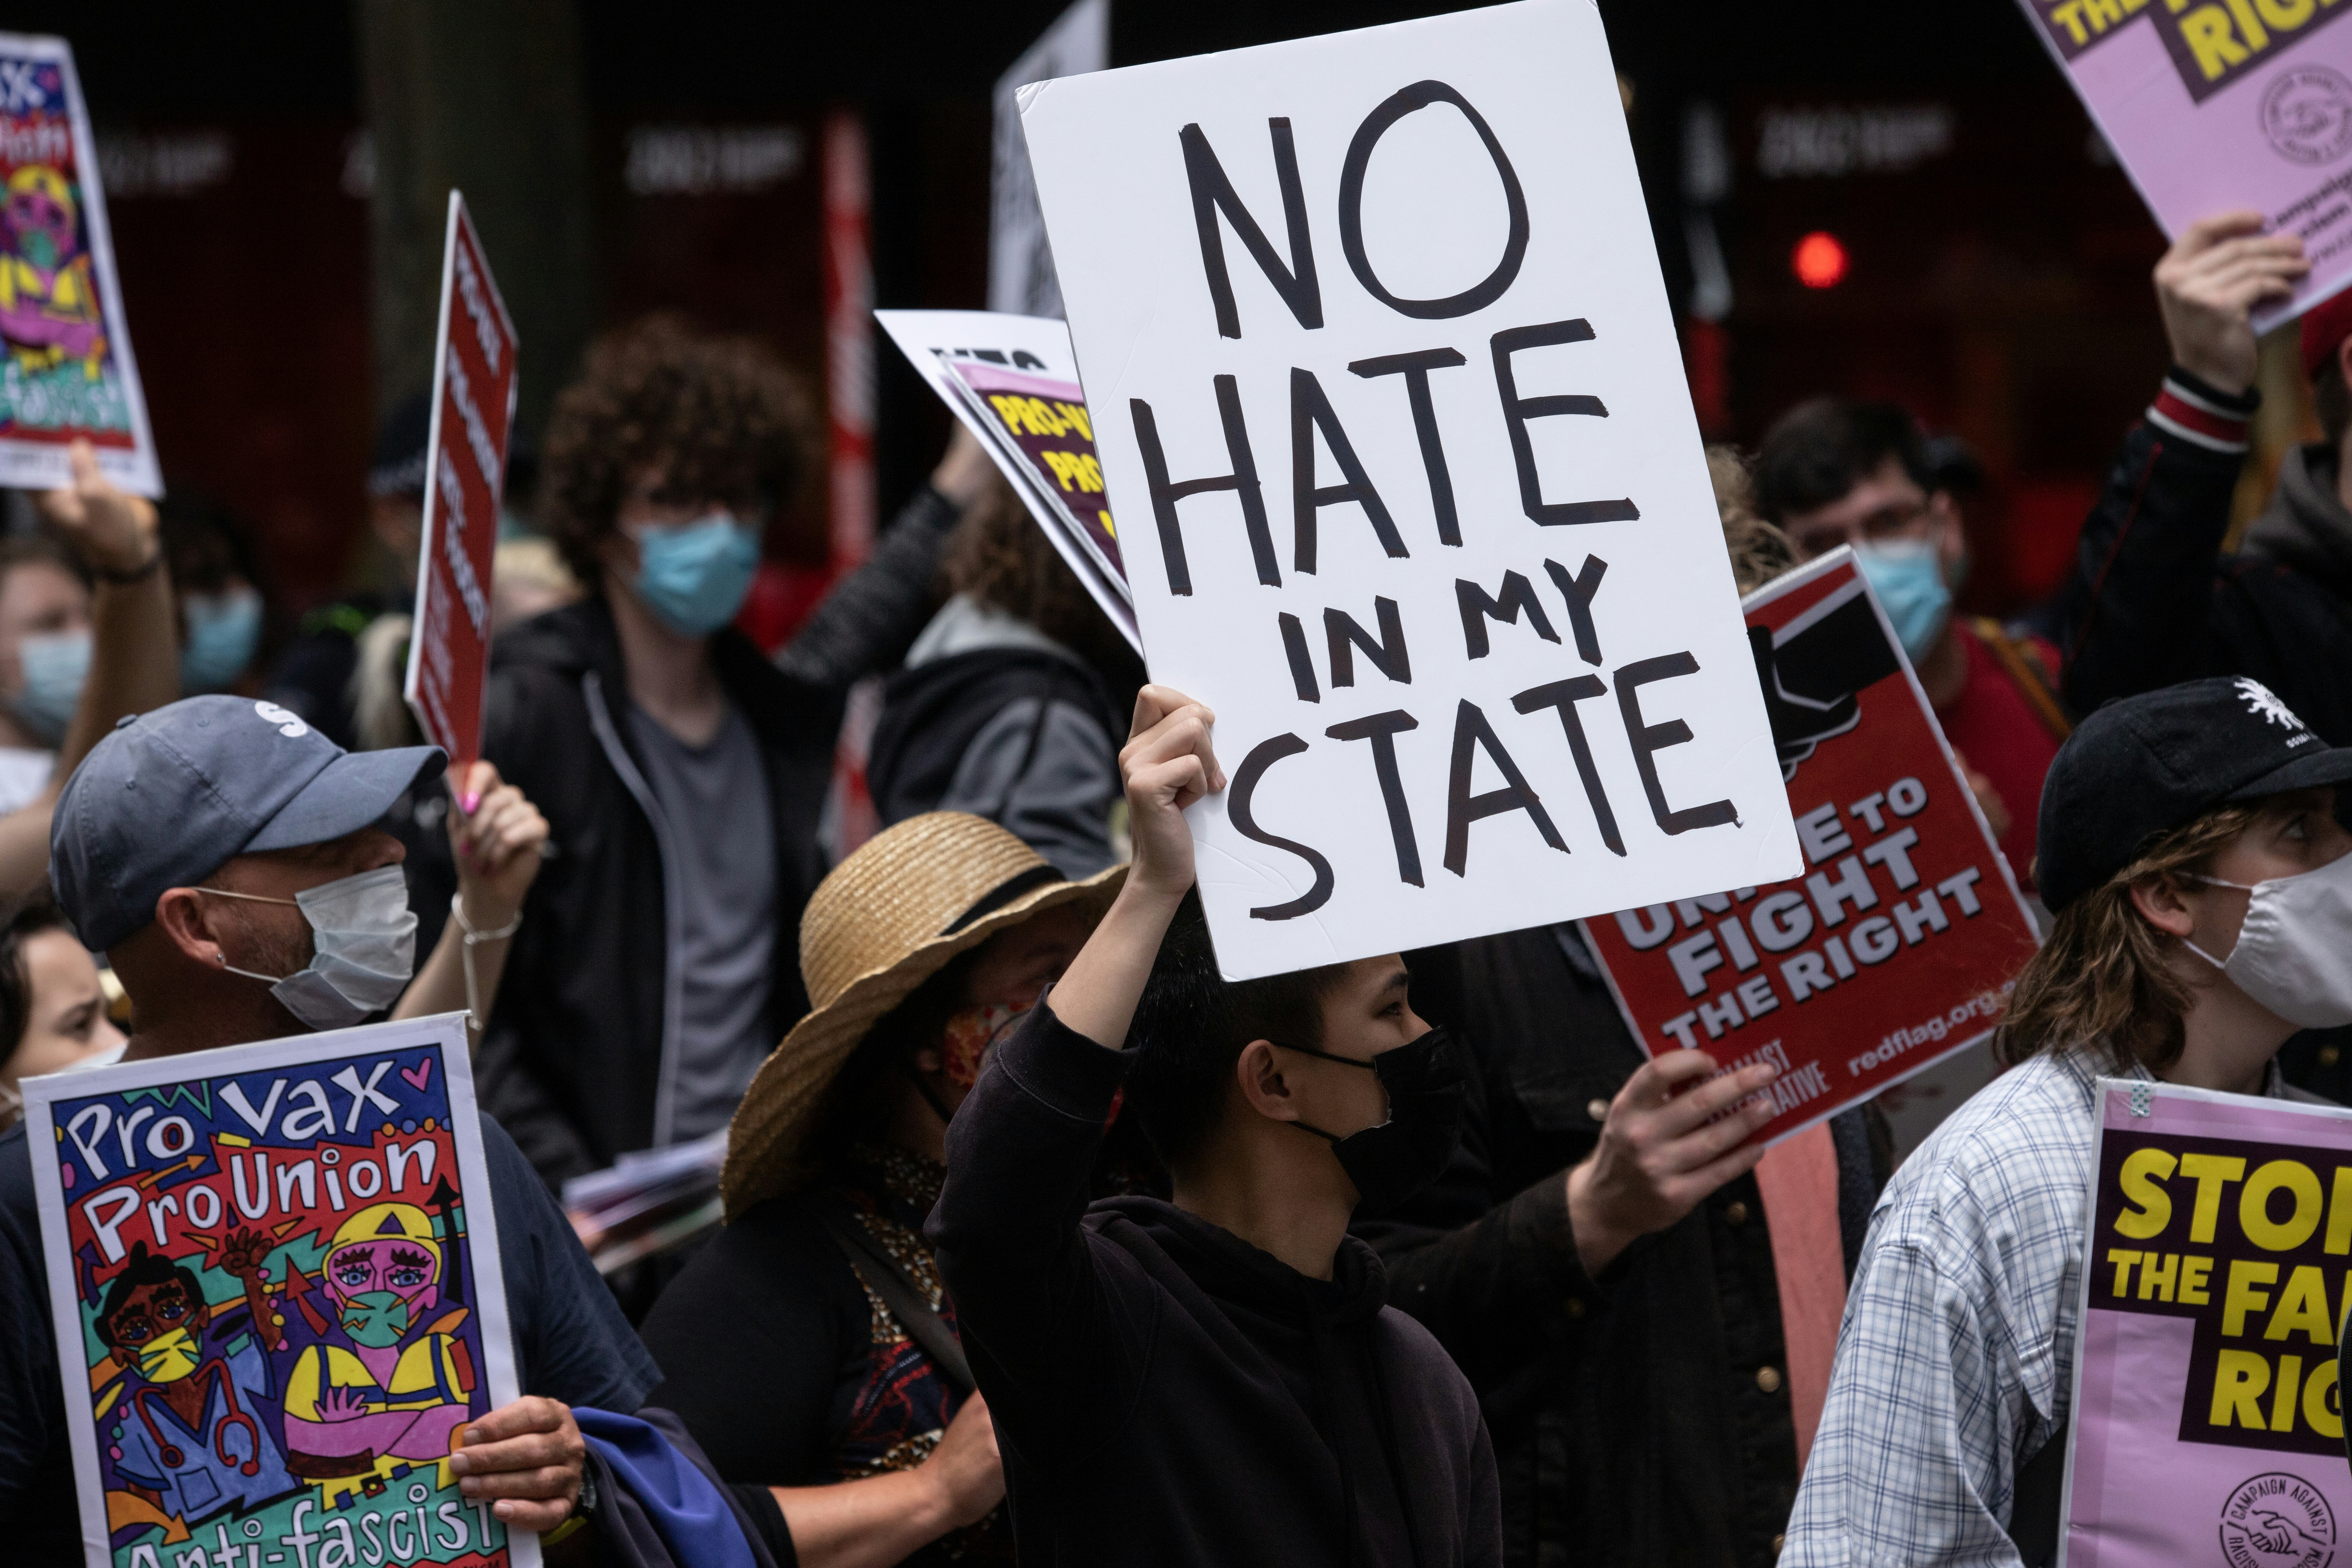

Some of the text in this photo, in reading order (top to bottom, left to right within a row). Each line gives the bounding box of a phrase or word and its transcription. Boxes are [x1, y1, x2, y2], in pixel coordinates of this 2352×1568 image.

[2178, 0, 2337, 81] RIG
[1179, 80, 1530, 340] NO
[1130, 318, 1640, 597] HATE
[1278, 553, 1608, 704] IN MY
[1227, 651, 1745, 921] STATE
[1614, 777, 1927, 950] UNE TO
[1667, 827, 1919, 997] FIGHT
[1661, 867, 1980, 1050] THE RIGHT
[67, 1104, 194, 1180] Pro
[83, 1139, 437, 1265] Pro Union
[2107, 1248, 2214, 1305] THE
[2222, 1260, 2352, 1346] FA
[2228, 1537, 2260, 1568] RACIS
[2230, 1479, 2327, 1535] CAMPAIGN AGAINST
